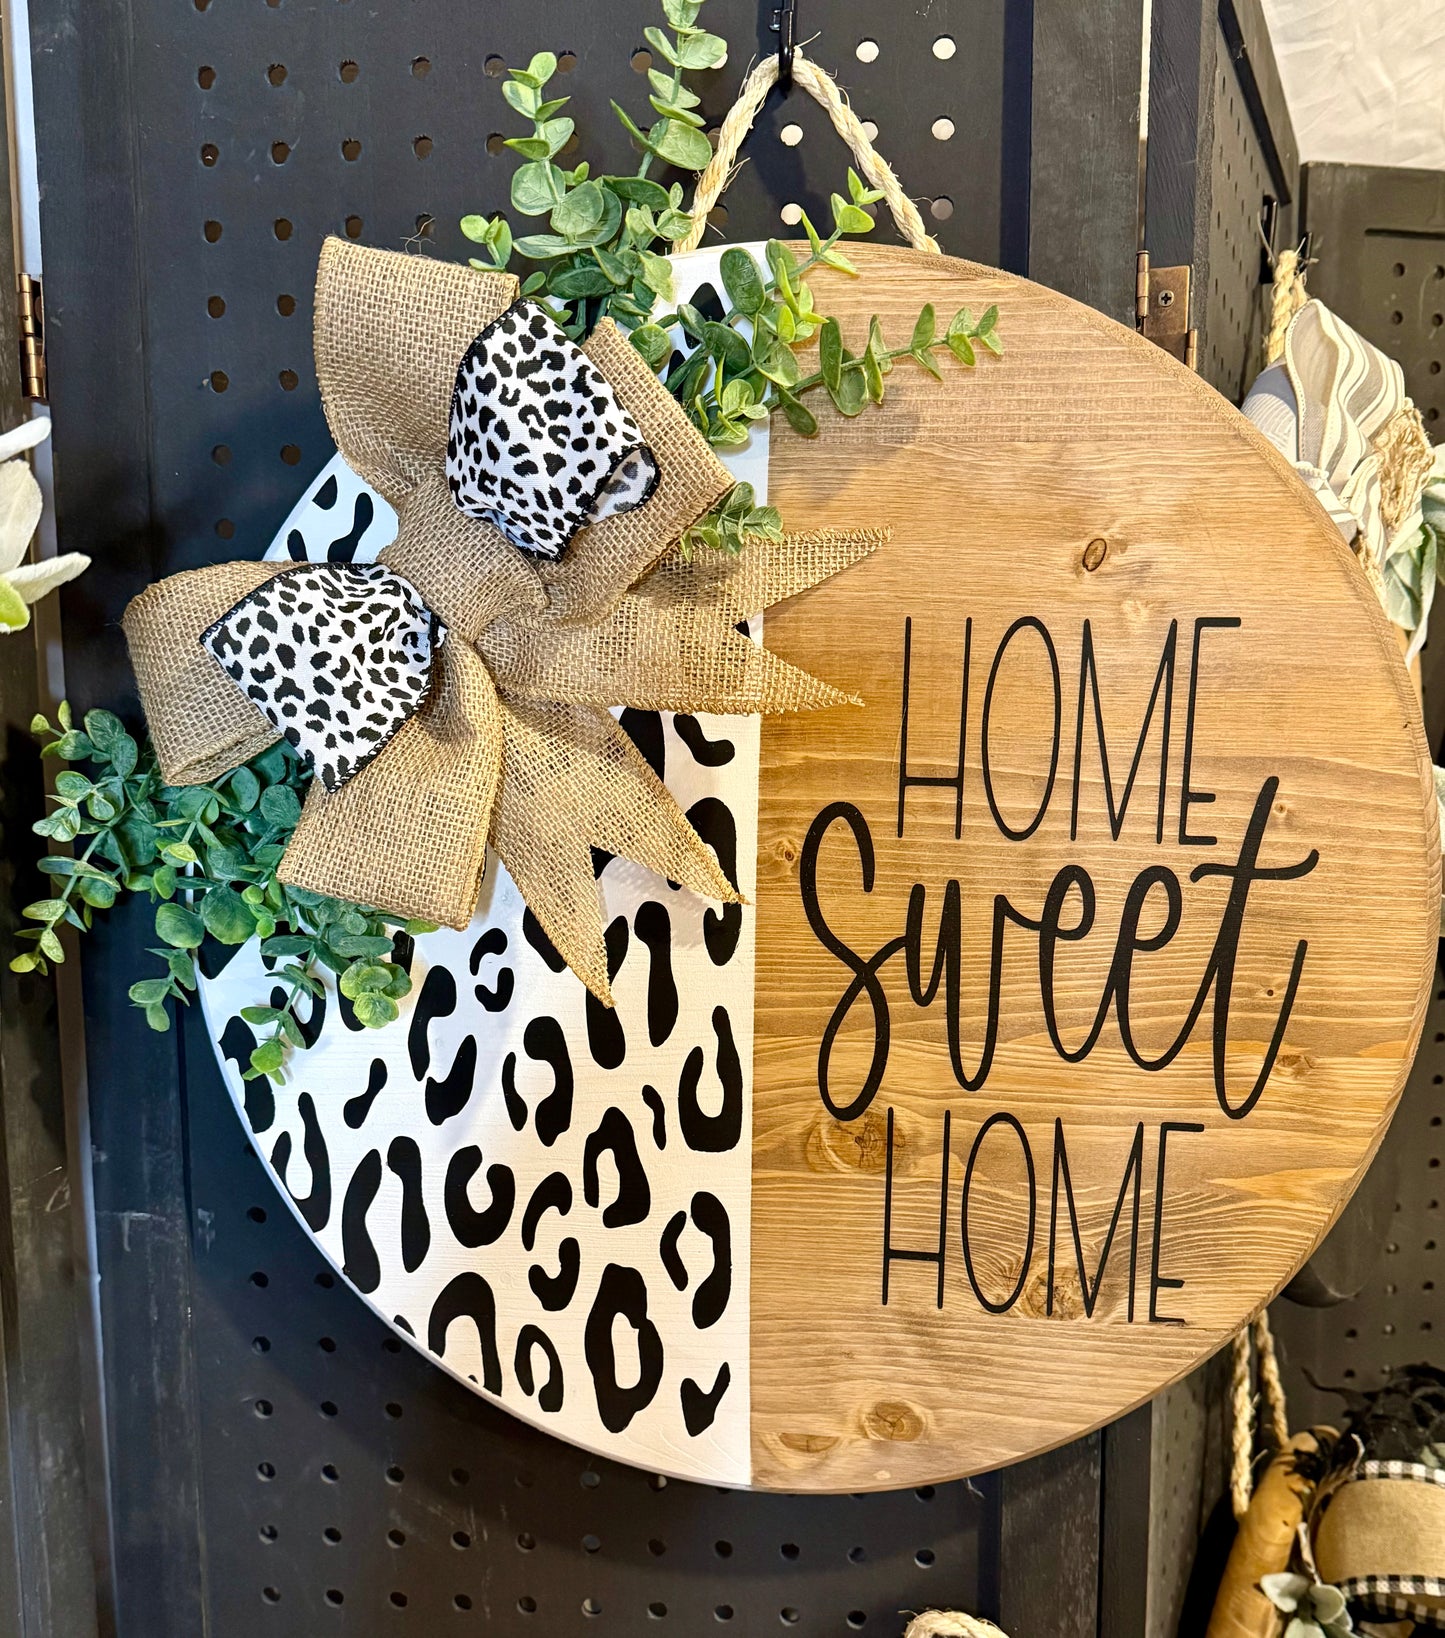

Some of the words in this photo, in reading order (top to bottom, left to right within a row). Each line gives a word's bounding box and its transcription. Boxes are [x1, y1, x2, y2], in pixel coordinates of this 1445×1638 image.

[896, 615, 1242, 846] HOME
[799, 775, 1320, 1121] Sweet
[880, 1106, 1206, 1324] HOME
